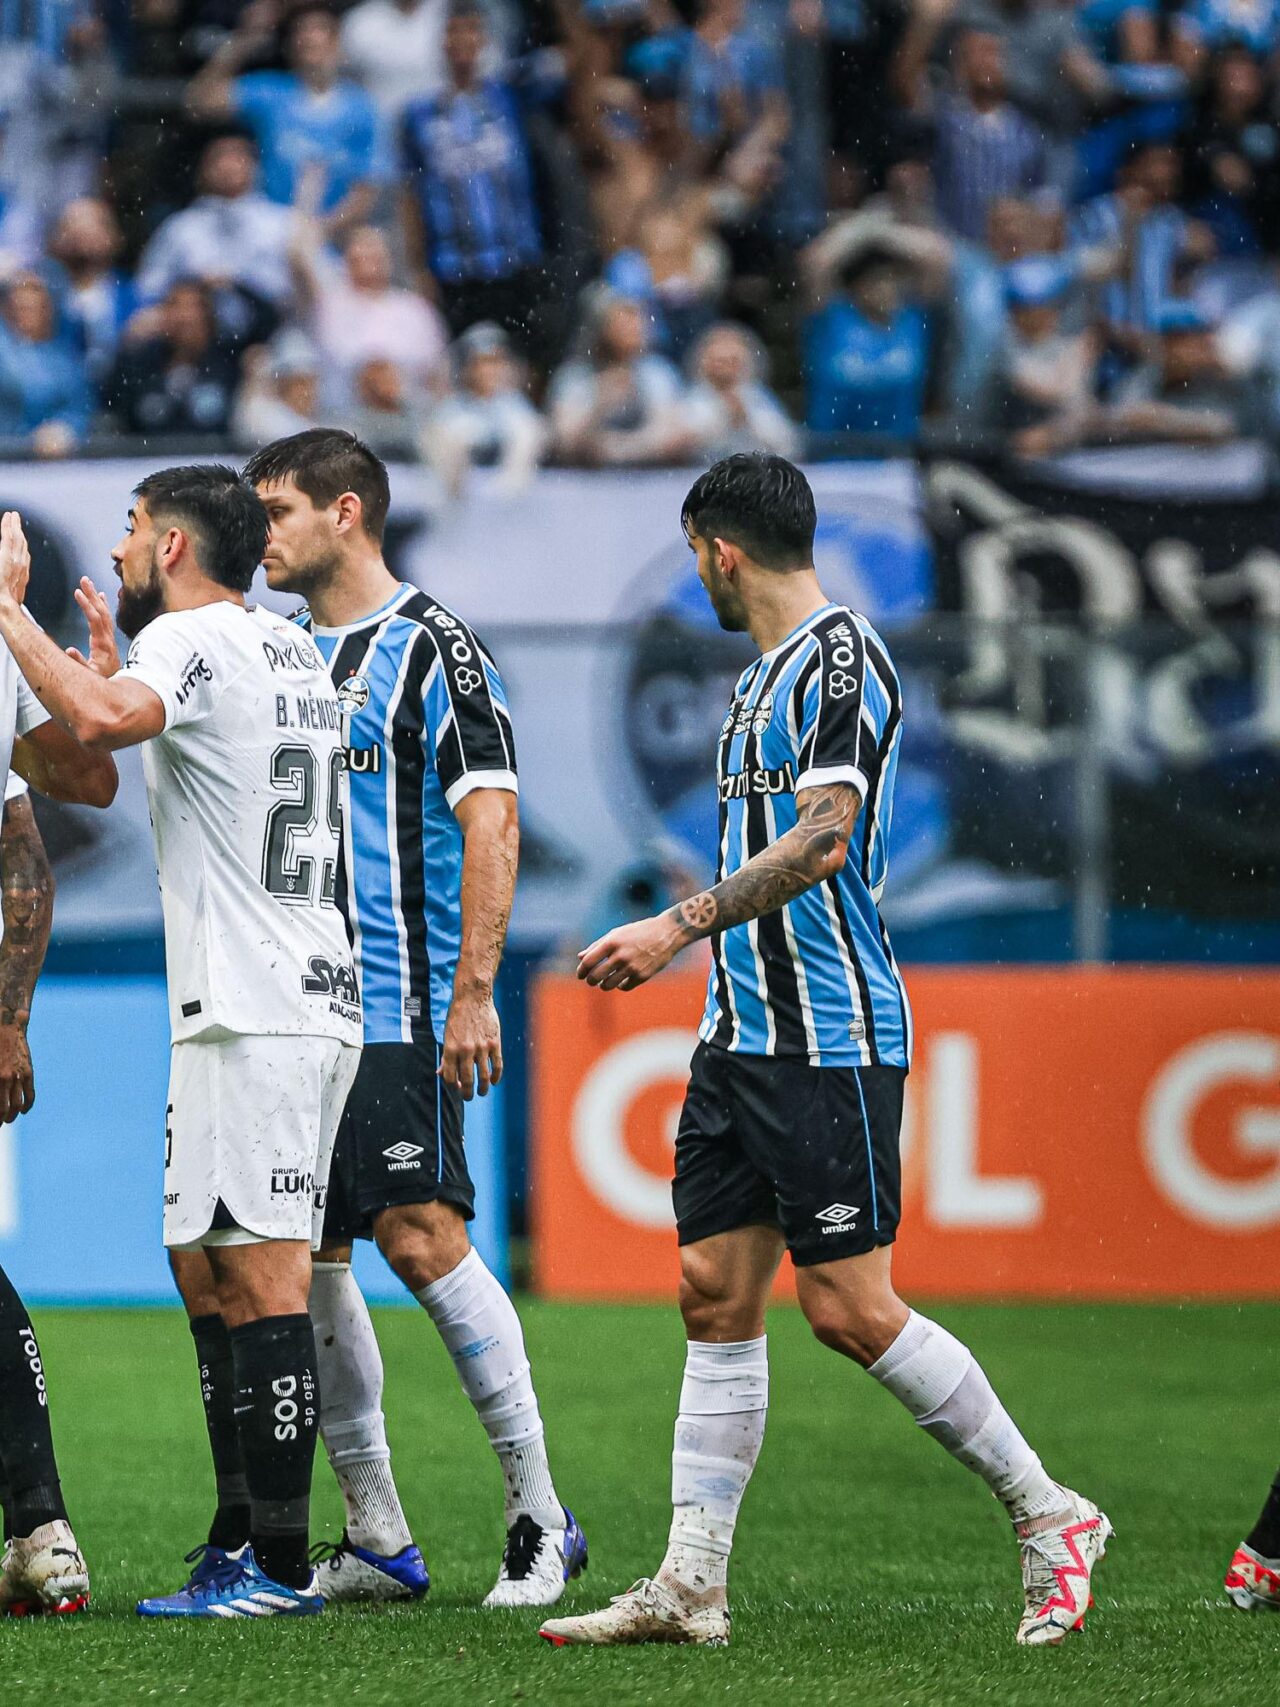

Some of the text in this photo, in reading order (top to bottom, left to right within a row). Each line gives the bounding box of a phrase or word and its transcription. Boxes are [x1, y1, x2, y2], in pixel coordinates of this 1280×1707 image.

[422, 604, 472, 663] vero
[825, 621, 855, 667] vero
[274, 692, 295, 729] B.
[271, 1167, 299, 1175] GRUPO
[387, 1159, 422, 1171] umbro
[821, 1222, 857, 1235] umbro
[18, 1326, 48, 1407] TODOS
[304, 1406, 316, 1427] de
